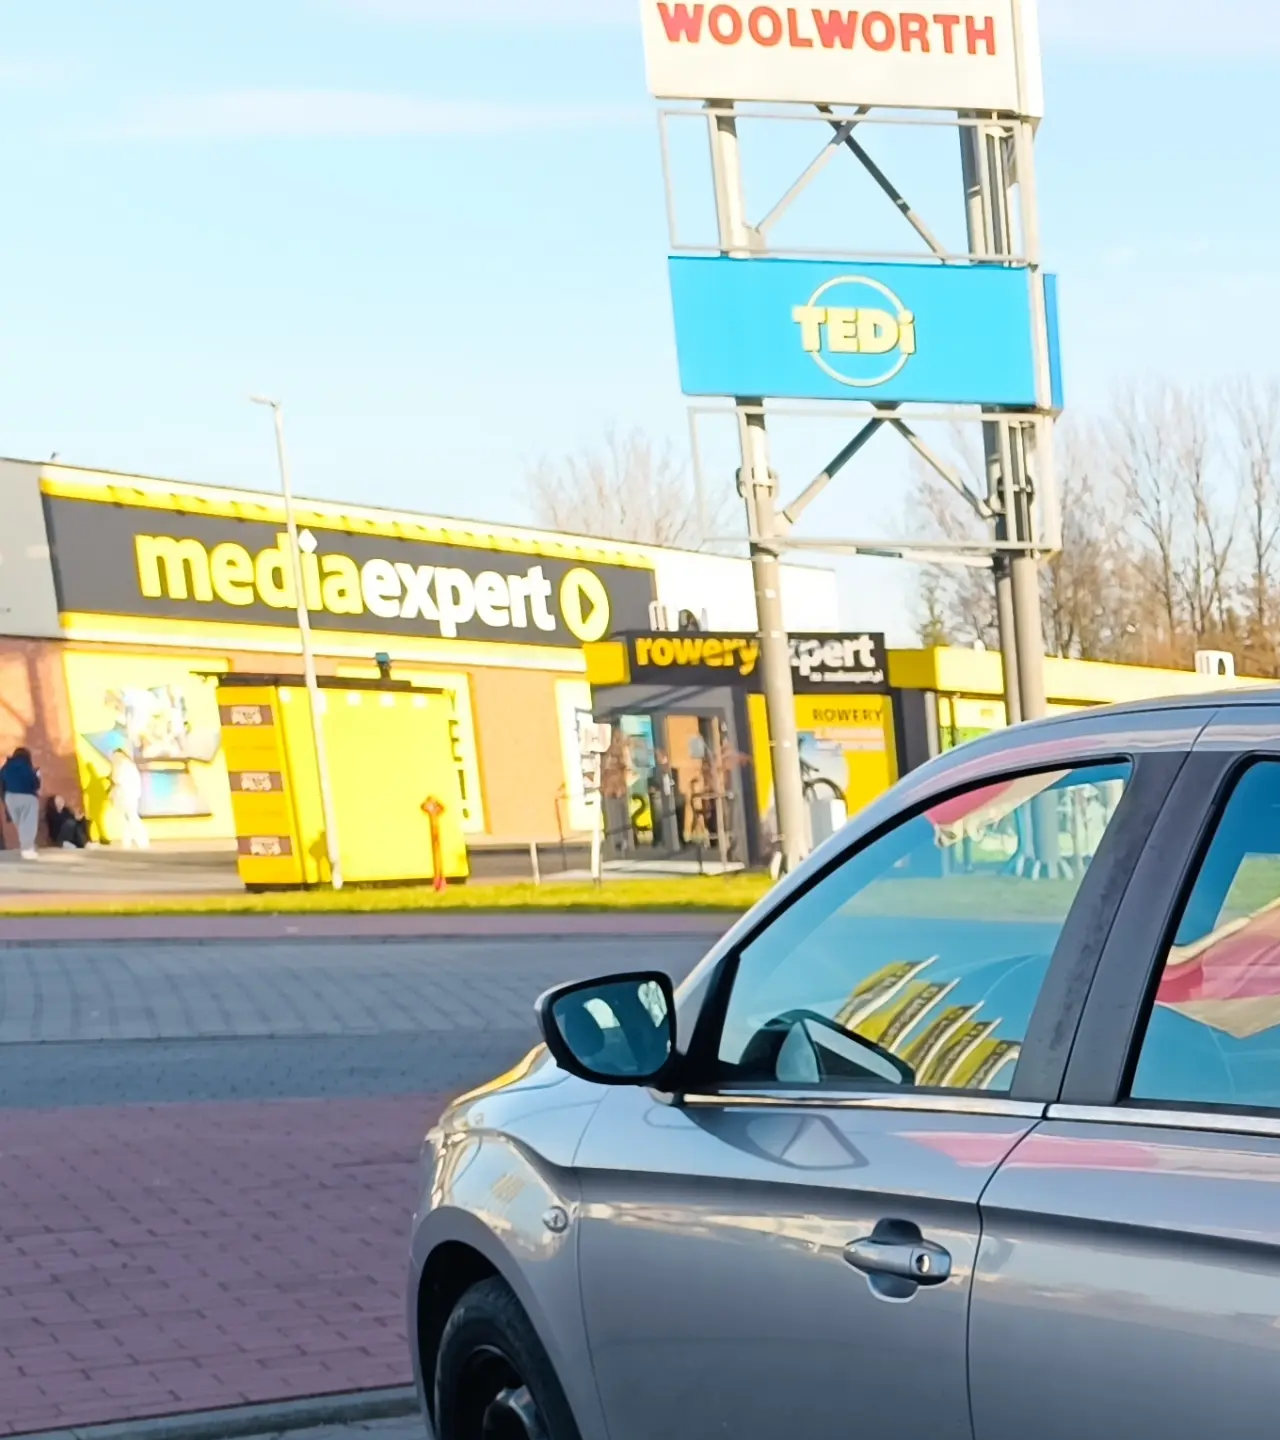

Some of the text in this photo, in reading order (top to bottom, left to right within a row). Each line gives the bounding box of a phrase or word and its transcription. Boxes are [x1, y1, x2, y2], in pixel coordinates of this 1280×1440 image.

[657, 3, 996, 55] WOOLWORTH
[792, 305, 915, 355] TEDi
[134, 529, 557, 638] mediaexpert
[812, 708, 882, 722] ROWERY
